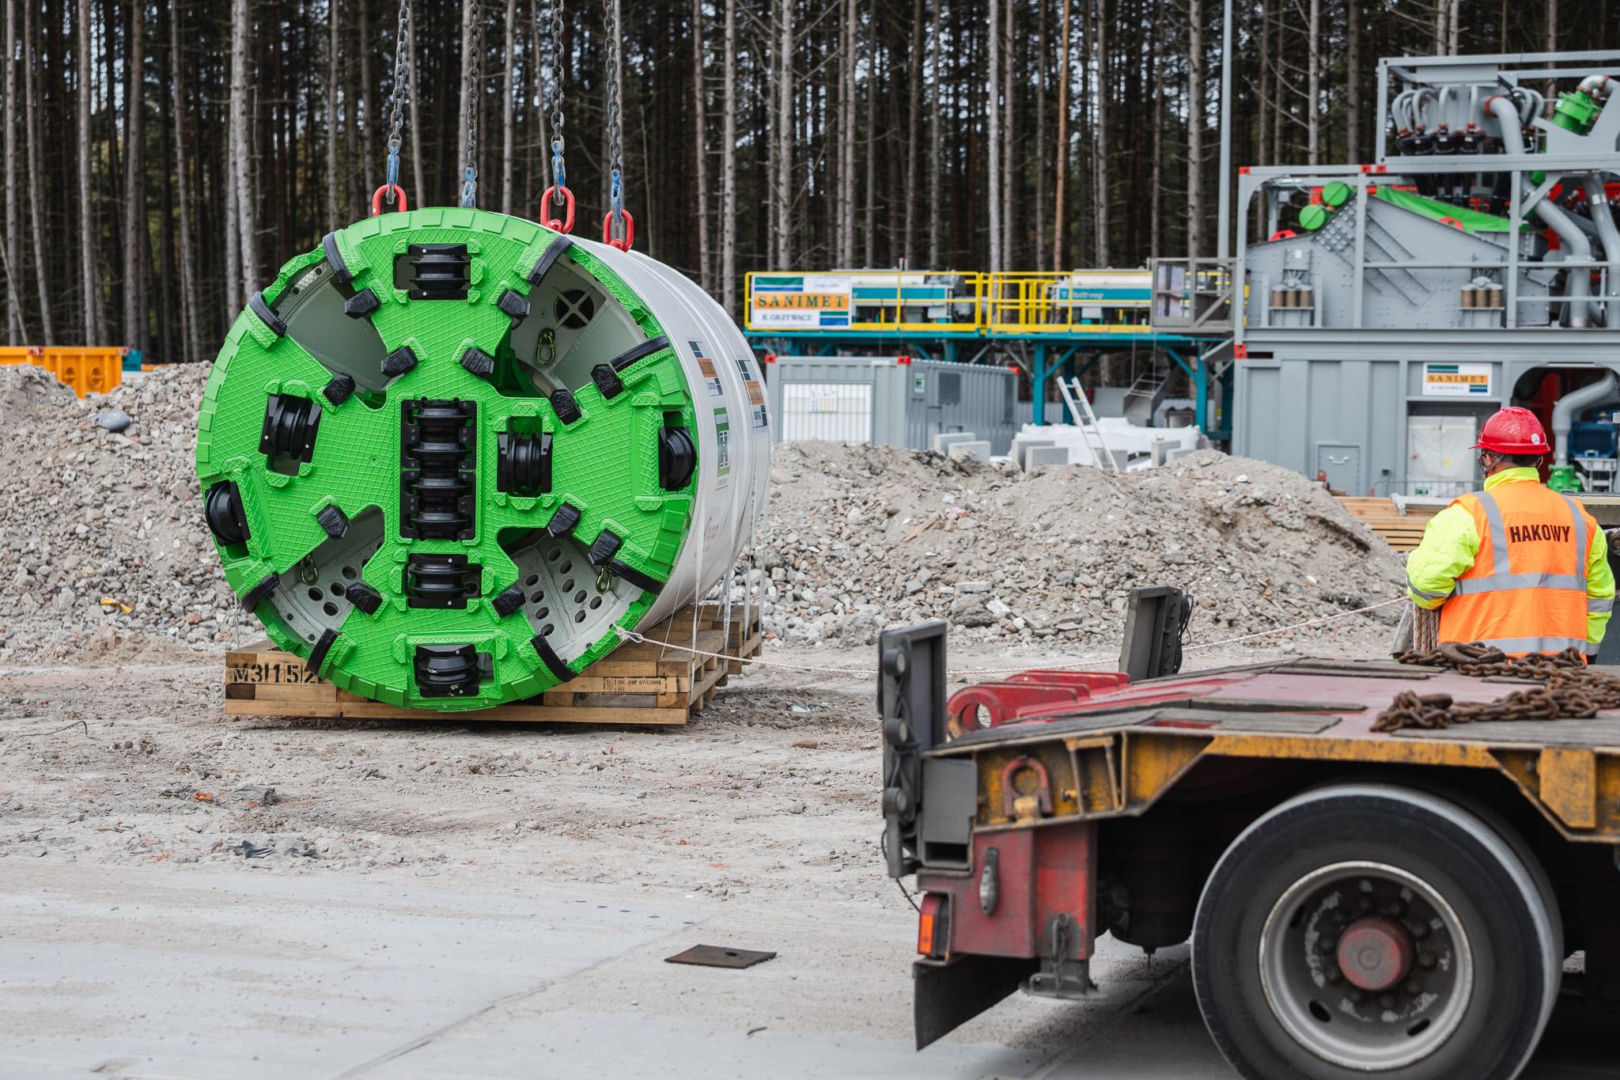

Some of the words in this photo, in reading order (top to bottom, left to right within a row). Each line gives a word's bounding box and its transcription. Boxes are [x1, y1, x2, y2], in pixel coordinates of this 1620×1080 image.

[758, 295, 844, 308] SANIMET
[1429, 375, 1486, 383] SANIMET
[1510, 524, 1570, 543] HAKOWY
